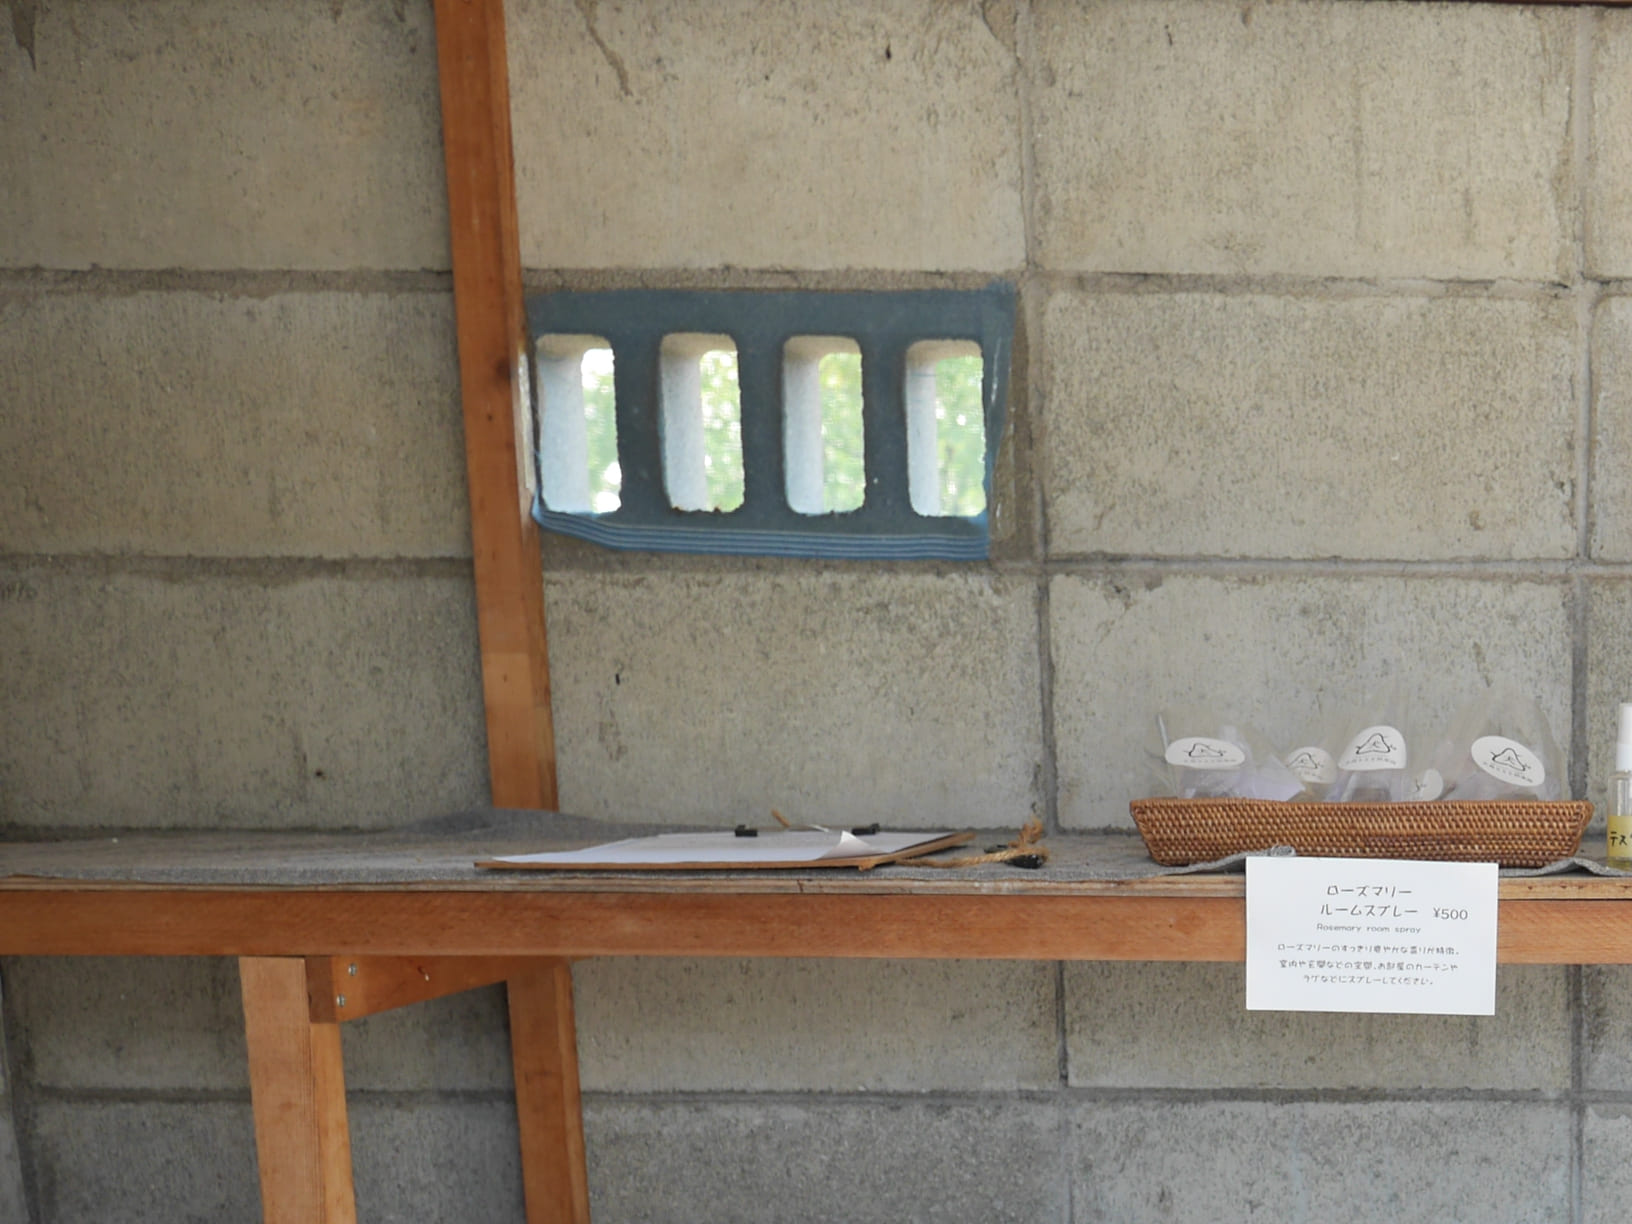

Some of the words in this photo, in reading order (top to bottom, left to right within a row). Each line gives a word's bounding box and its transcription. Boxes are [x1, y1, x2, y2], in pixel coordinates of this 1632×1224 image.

[1326, 885, 1413, 898] ローズマリー
[1320, 904, 1418, 917] ルームスプレー
[1433, 907, 1469, 920] ¥500
[1316, 923, 1362, 933] Rosemary
[1395, 925, 1421, 934] spray
